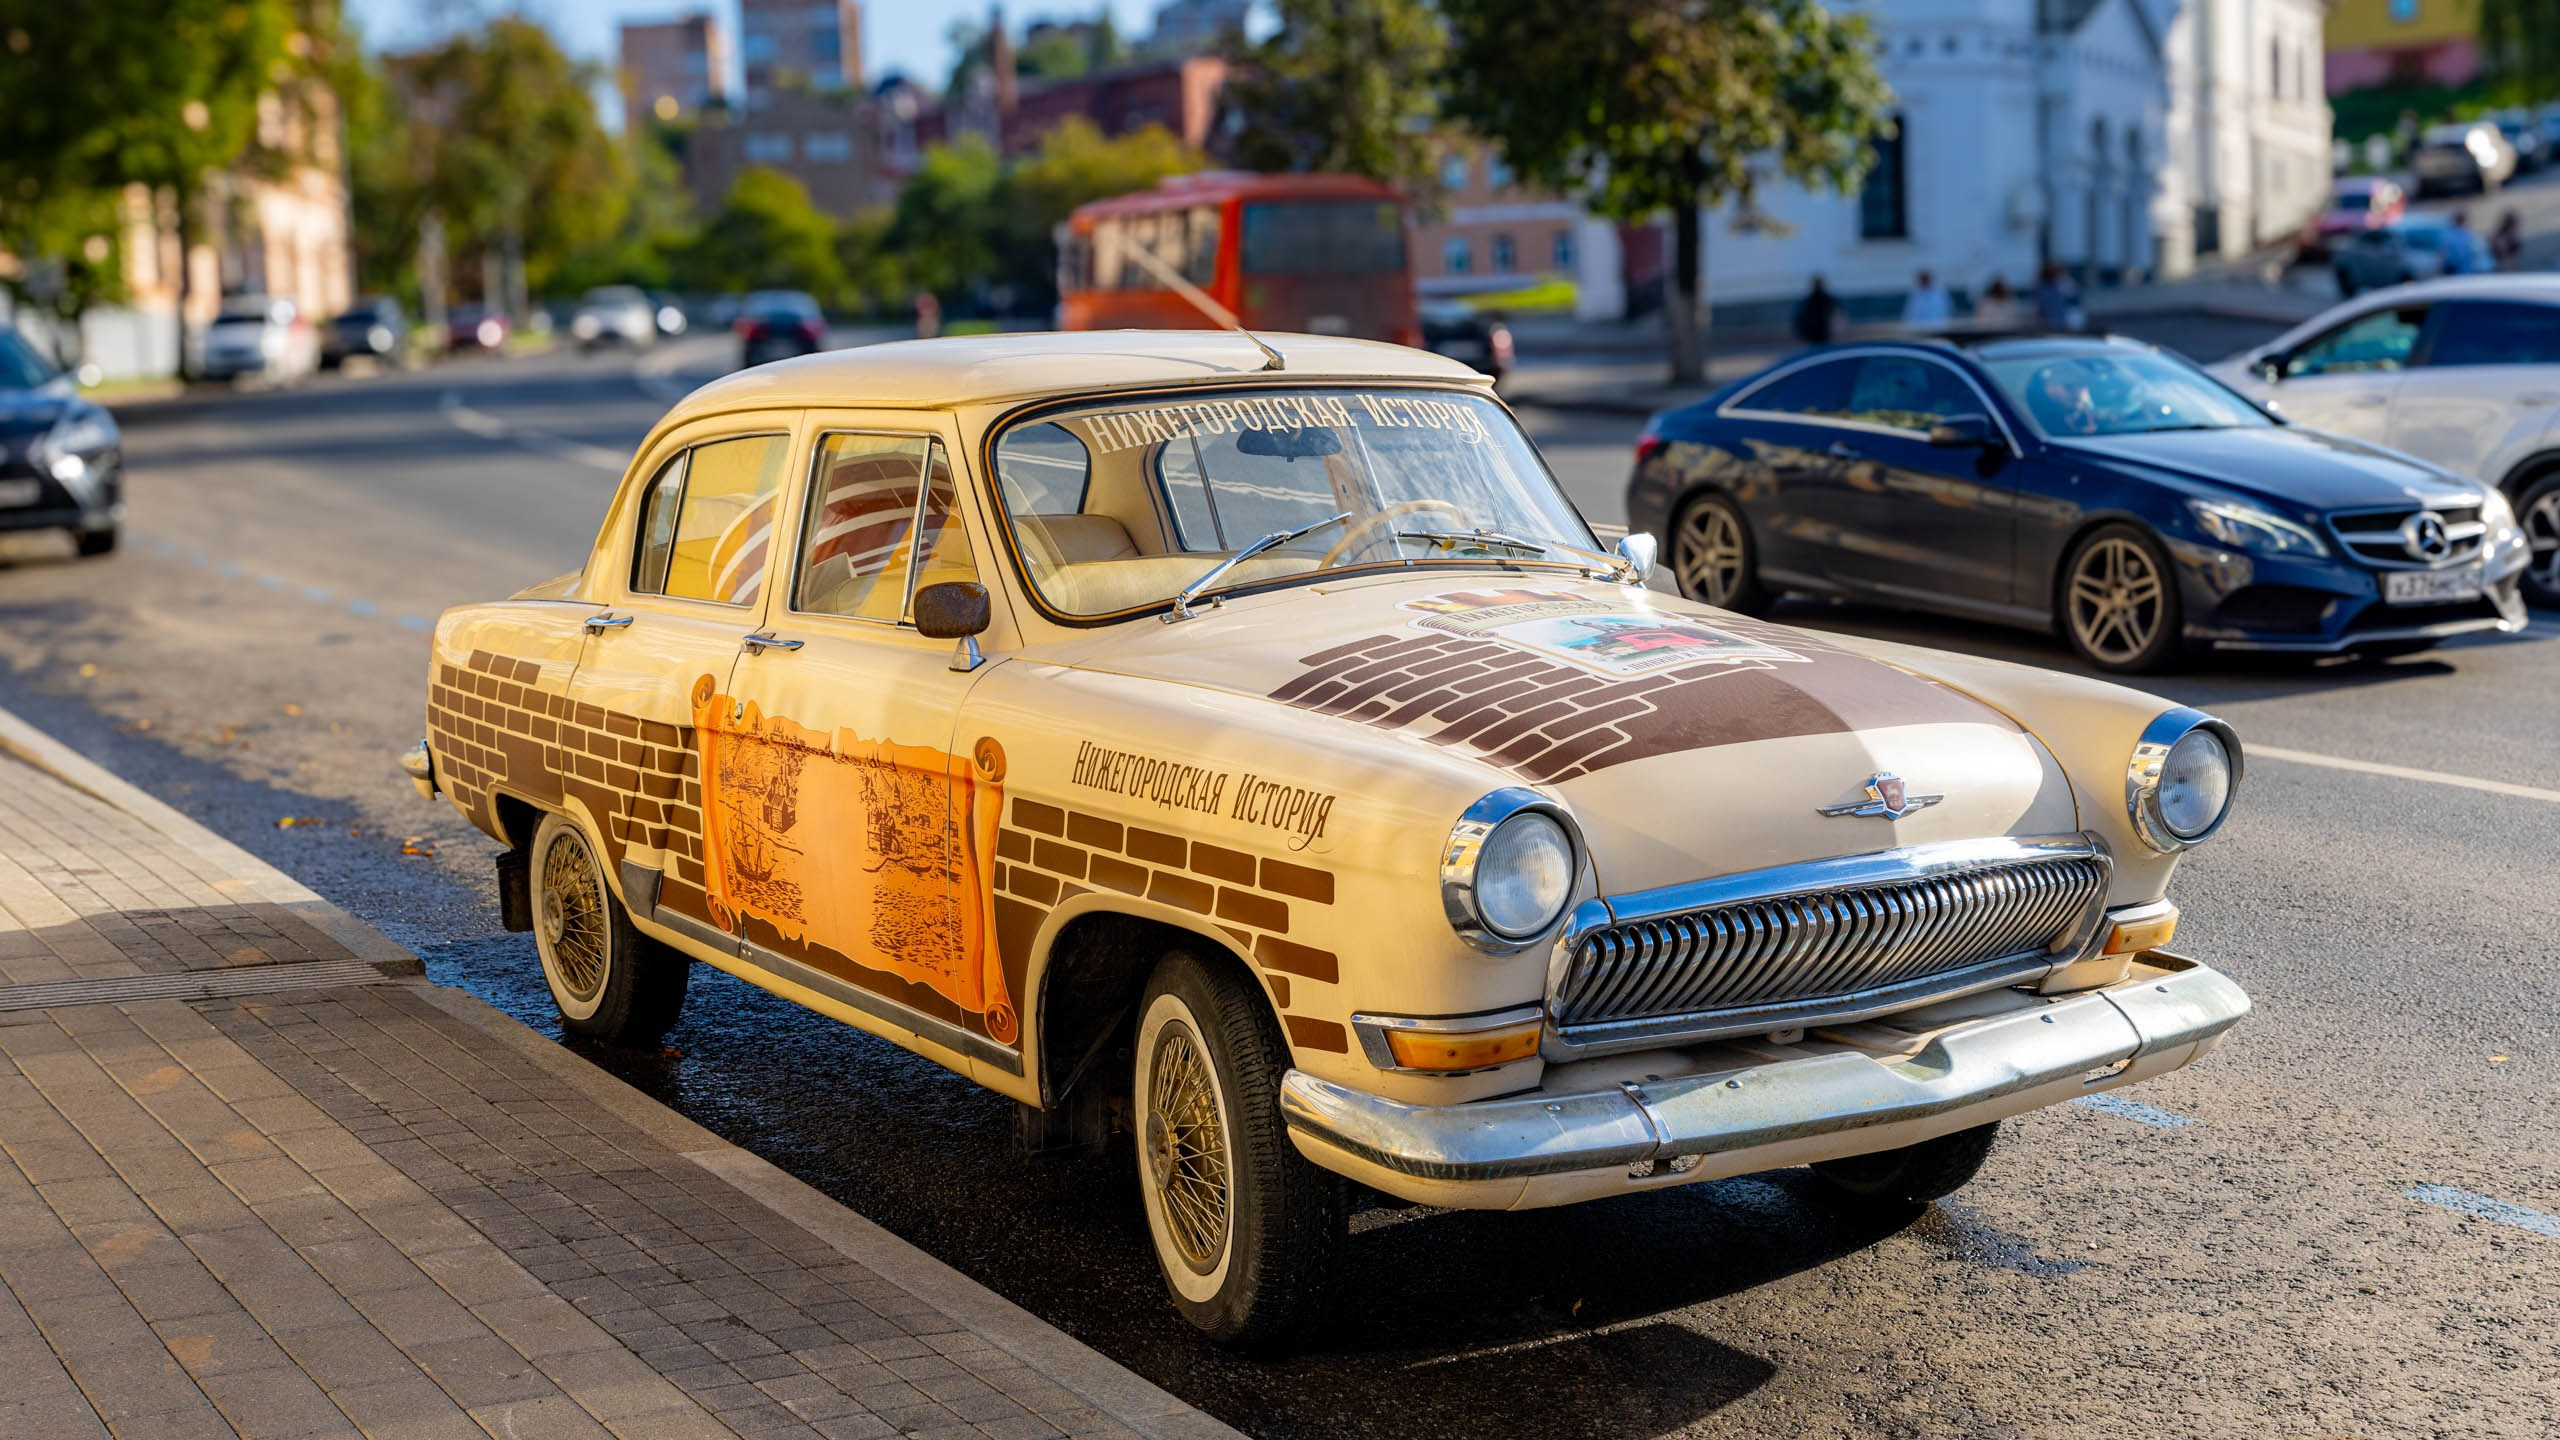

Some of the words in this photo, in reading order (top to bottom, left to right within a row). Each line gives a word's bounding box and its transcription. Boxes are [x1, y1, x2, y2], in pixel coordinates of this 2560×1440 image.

[1083, 396, 1357, 454] НИЖЕГОРОДСКАЯ
[1356, 394, 1491, 444] ИСТОРИЯ
[1072, 740, 1228, 814] НИЖЕГОРОДСКАЯ
[1231, 773, 1336, 853] ИСТОРИЯ
